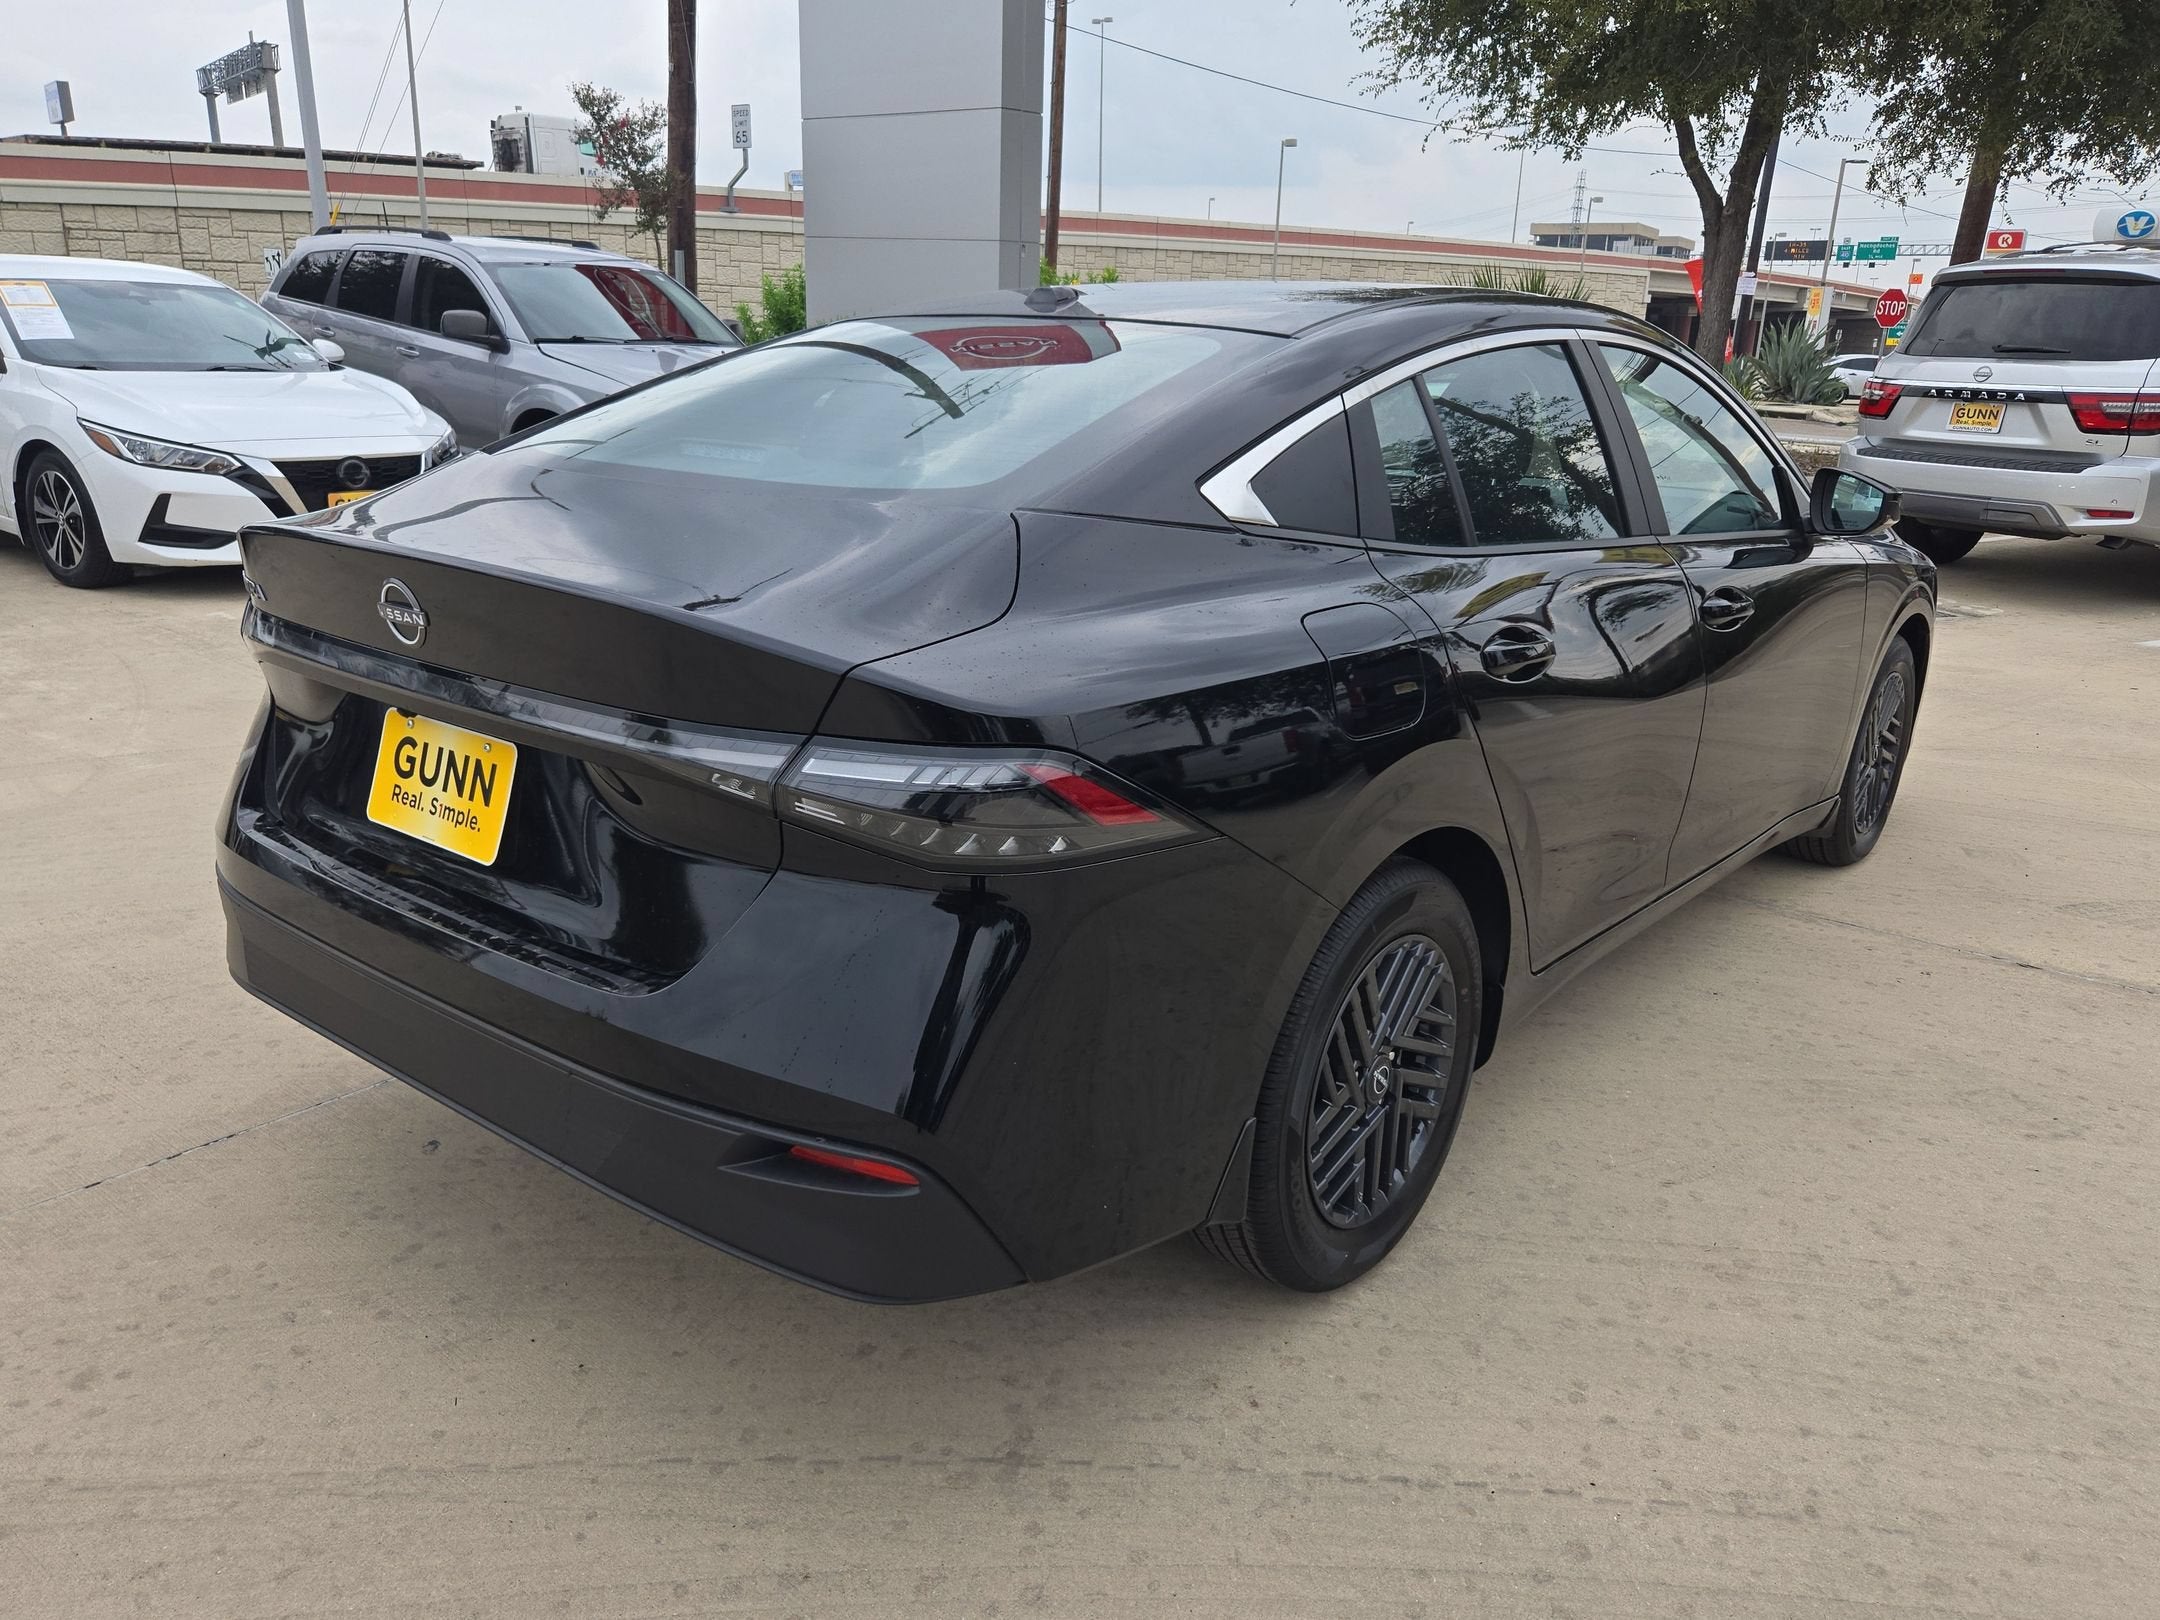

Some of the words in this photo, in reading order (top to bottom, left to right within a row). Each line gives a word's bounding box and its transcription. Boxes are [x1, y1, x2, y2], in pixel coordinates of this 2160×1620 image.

[735, 130, 748, 143] 65
[1877, 300, 1906, 316] STOP
[1927, 388, 2025, 401] ARMADA
[1956, 407, 2000, 420] GUNN
[394, 736, 497, 808] GUNN
[392, 784, 424, 812] Real.
